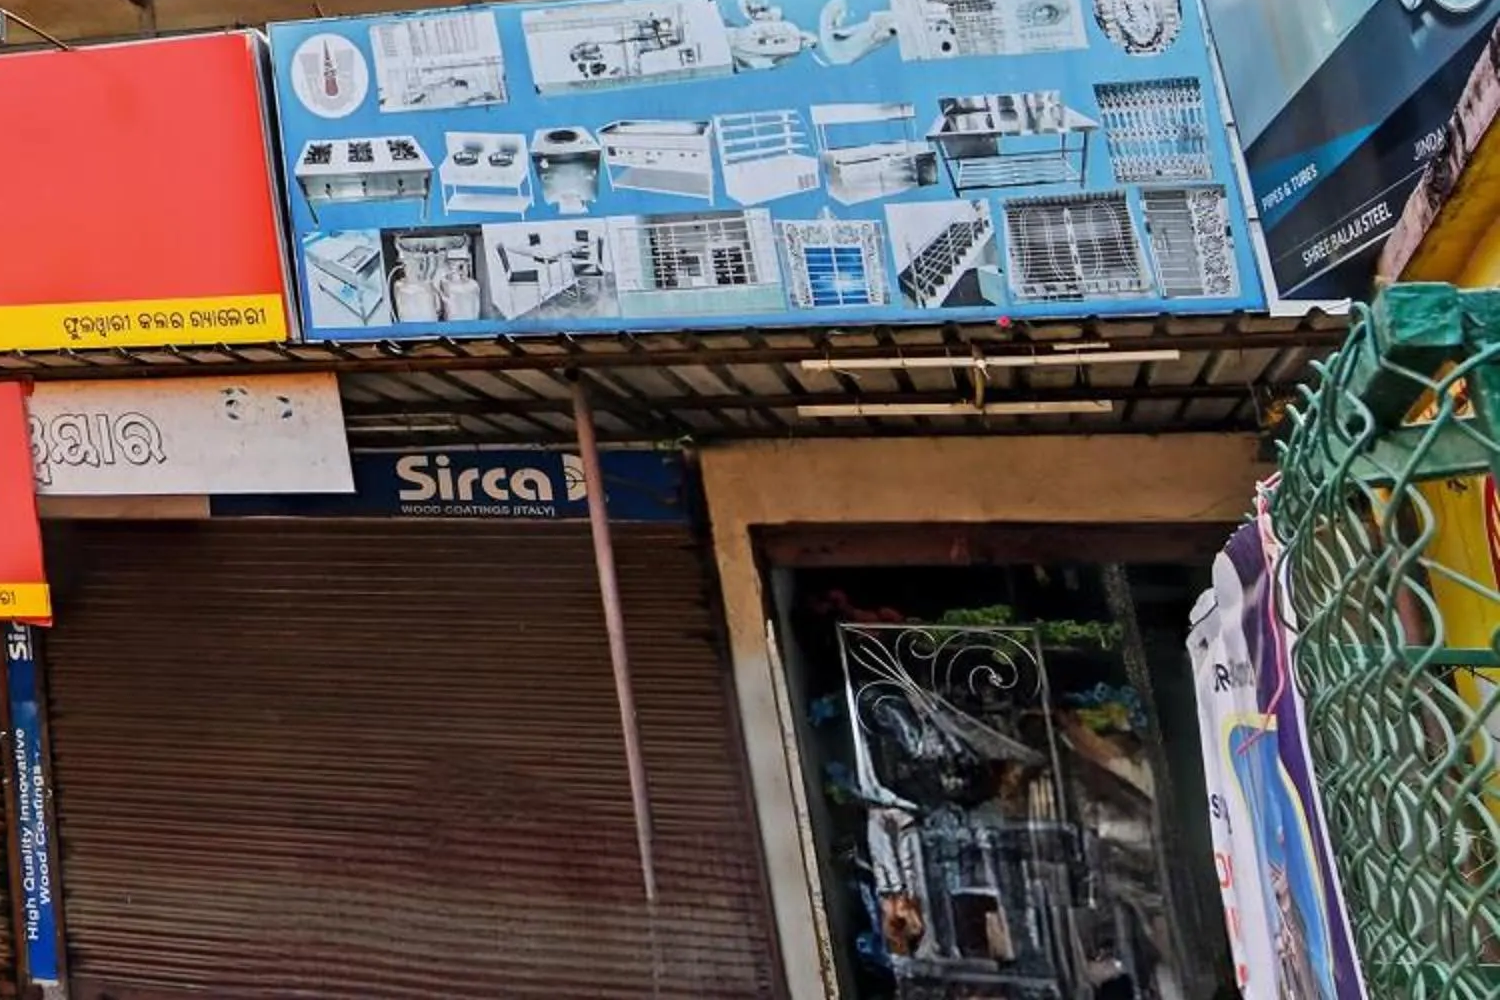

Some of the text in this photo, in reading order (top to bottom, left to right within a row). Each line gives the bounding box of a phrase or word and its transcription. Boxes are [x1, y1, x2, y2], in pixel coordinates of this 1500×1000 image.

[1361, 200, 1393, 232] STEEL
[396, 453, 553, 501] Sirca
[401, 504, 442, 515] WOOD
[444, 505, 511, 516] COATINGS
[15, 727, 41, 942] High Quality Innovative
[33, 763, 52, 906] Wood Coatings
